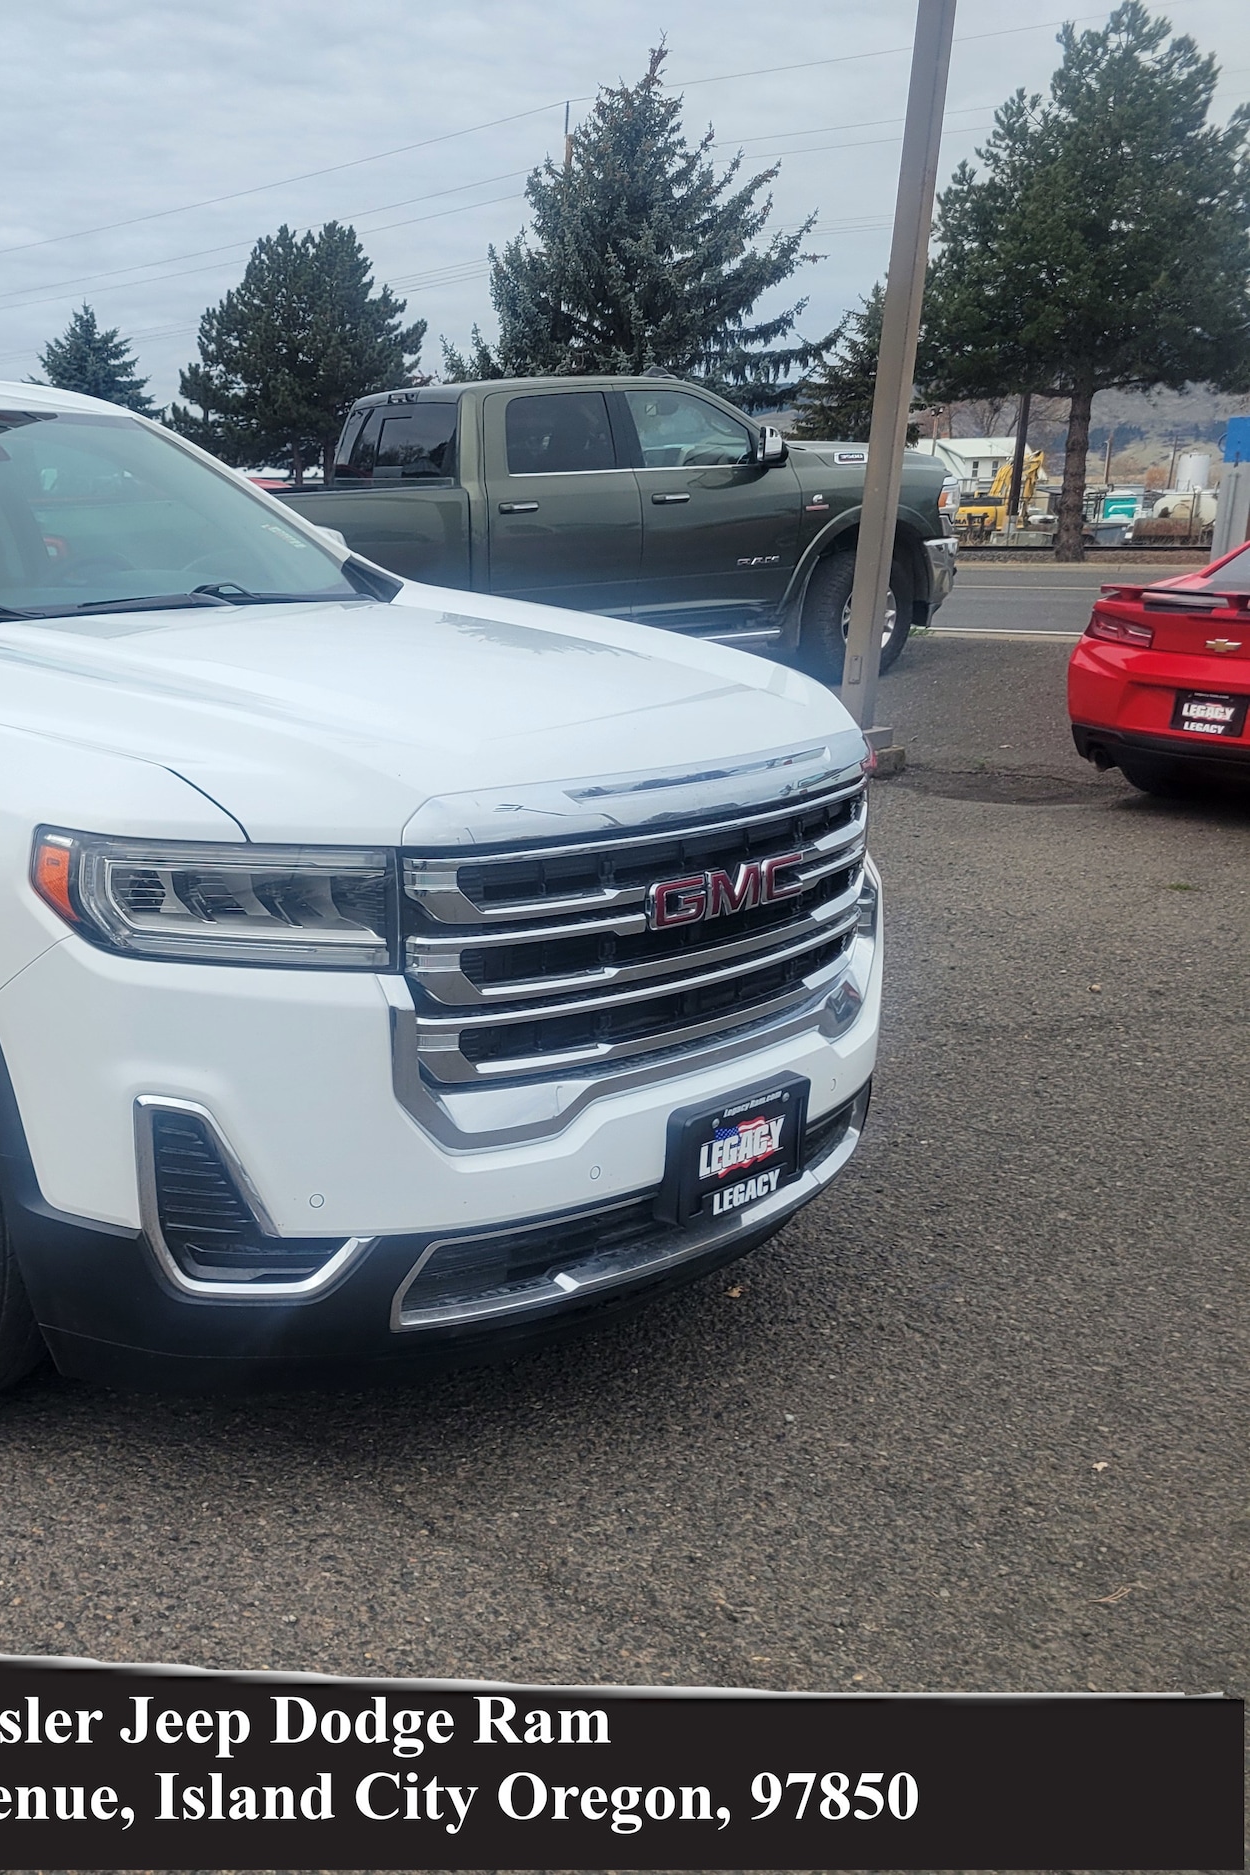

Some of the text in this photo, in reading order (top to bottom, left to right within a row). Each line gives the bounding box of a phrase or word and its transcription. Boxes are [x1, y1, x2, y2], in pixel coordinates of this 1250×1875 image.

[737, 555, 780, 566] RAM
[1181, 702, 1235, 721] LEGACY
[1183, 721, 1225, 735] LEGACY
[649, 853, 806, 931] GMC
[699, 1117, 785, 1178] LEGACY
[712, 1168, 781, 1216] LEGACY
